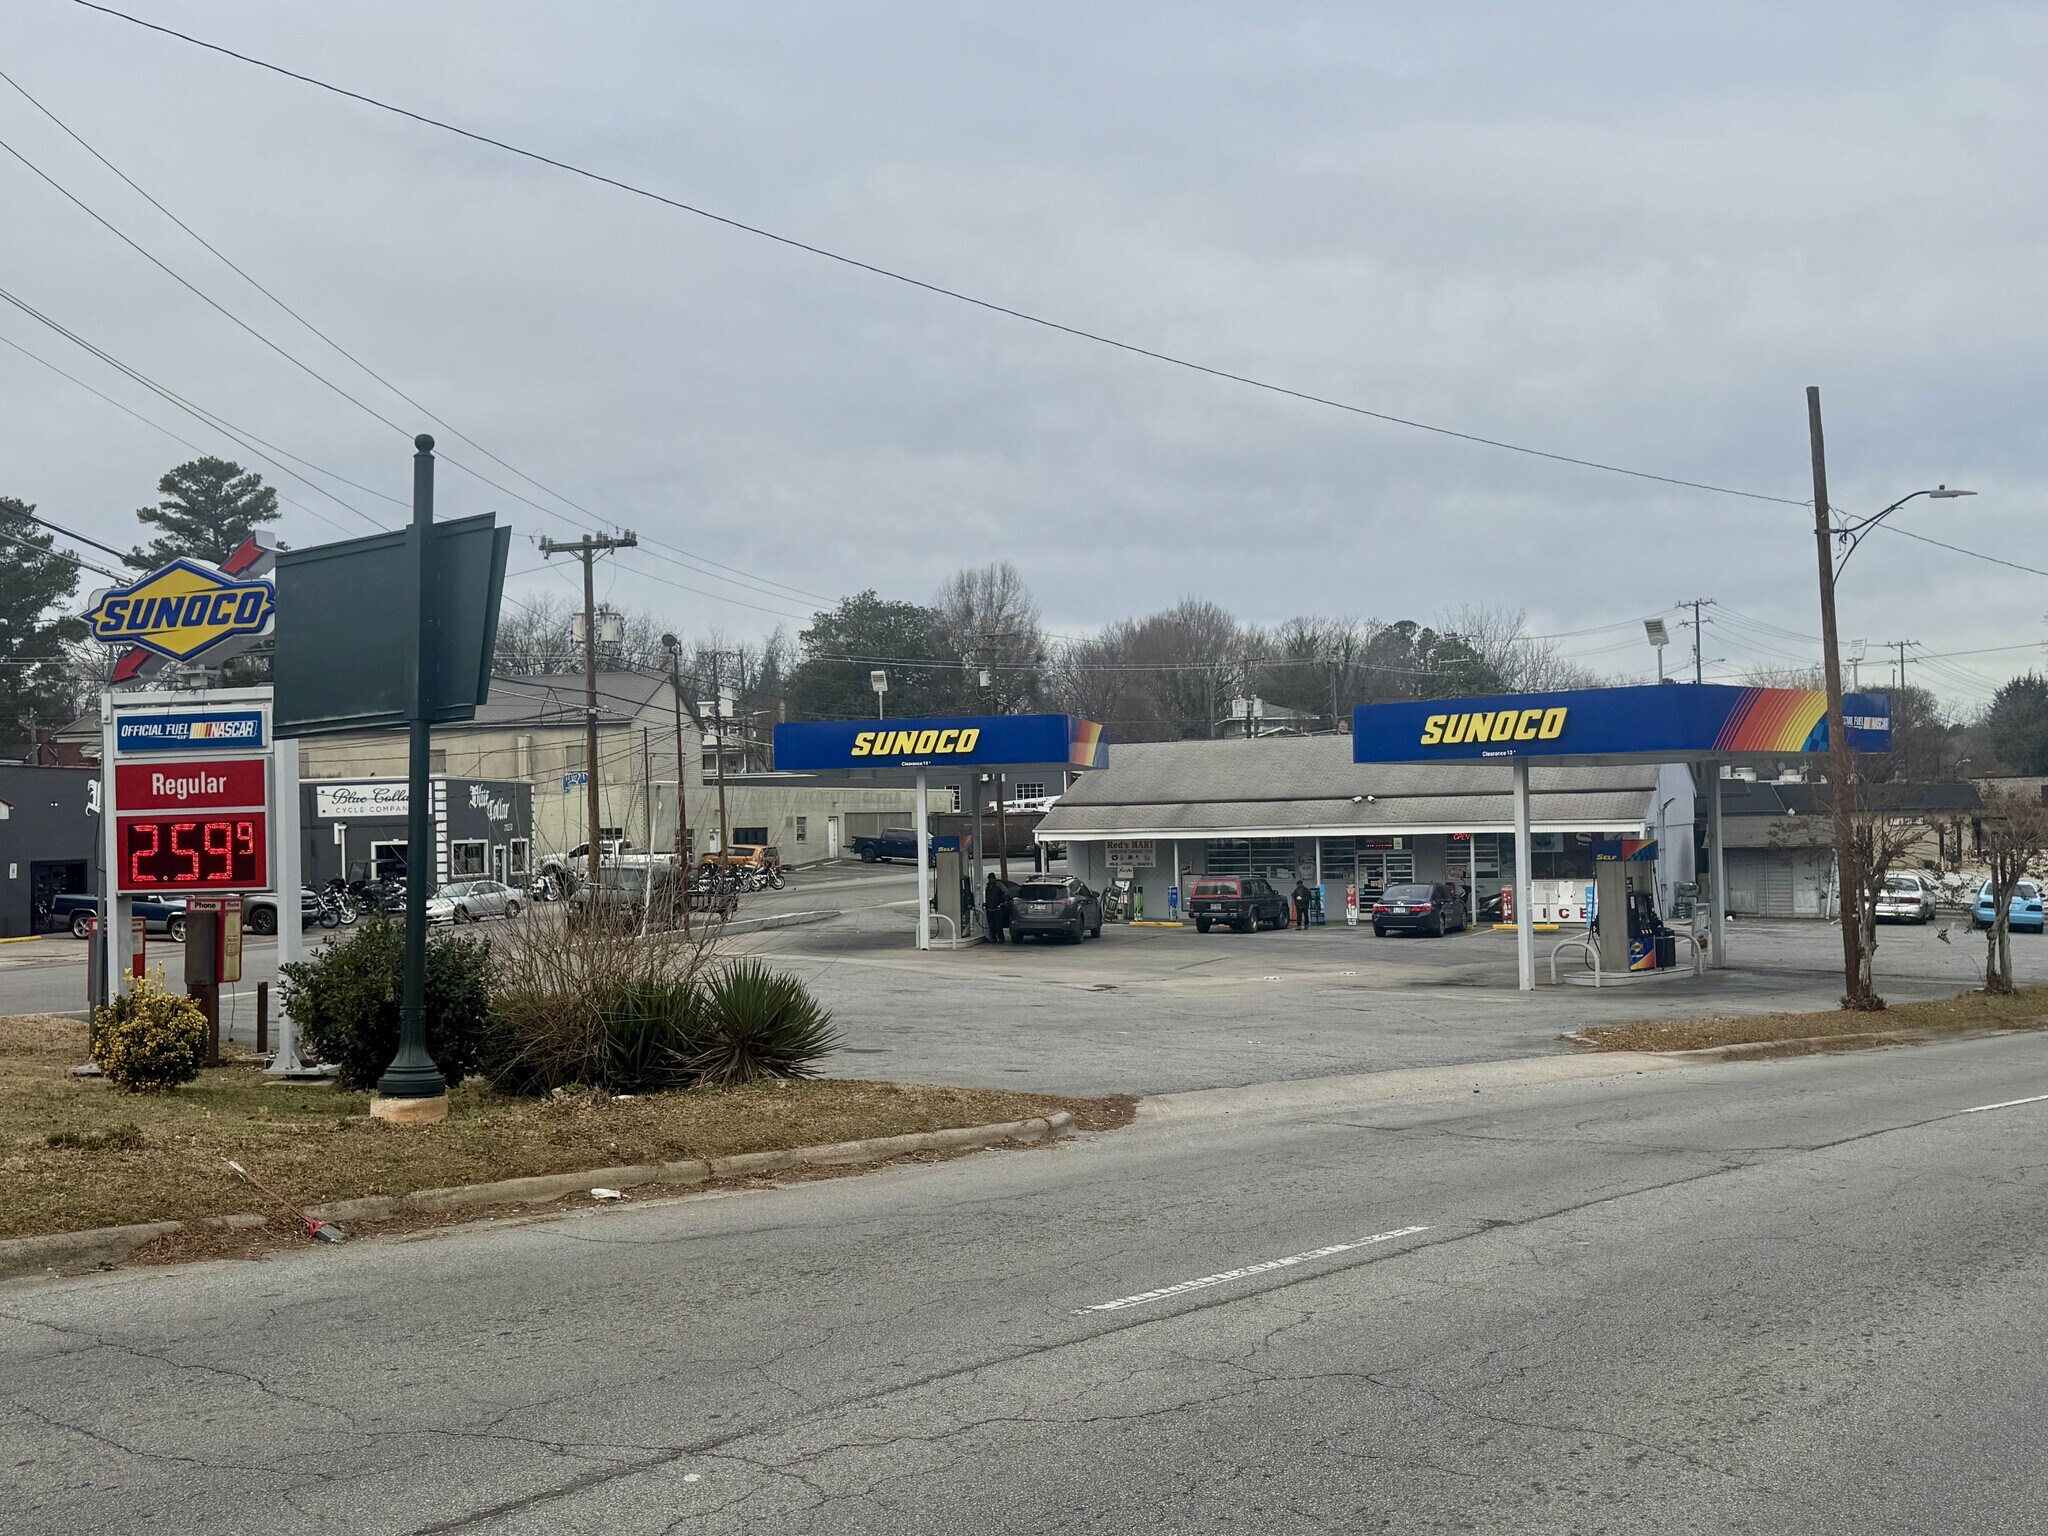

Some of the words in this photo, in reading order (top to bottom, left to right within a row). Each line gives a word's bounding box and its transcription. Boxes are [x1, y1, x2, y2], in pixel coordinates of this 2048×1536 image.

[100, 591, 266, 632] SUNOCO
[121, 724, 164, 737] OFFICIAL
[165, 723, 190, 735] FUEL
[210, 721, 255, 738] NASCAR
[1420, 707, 1568, 745] SUNOCO
[851, 728, 980, 756] SUNOCO
[151, 771, 227, 800] Regular
[331, 787, 368, 805] Blue
[372, 787, 409, 804] Colla
[369, 805, 408, 813] COMPAN
[1106, 840, 1130, 849] Red's
[1131, 840, 1154, 849] MART
[1453, 833, 1471, 841] OPEN
[194, 901, 217, 909] Phone
[1542, 907, 1588, 920] ICE
